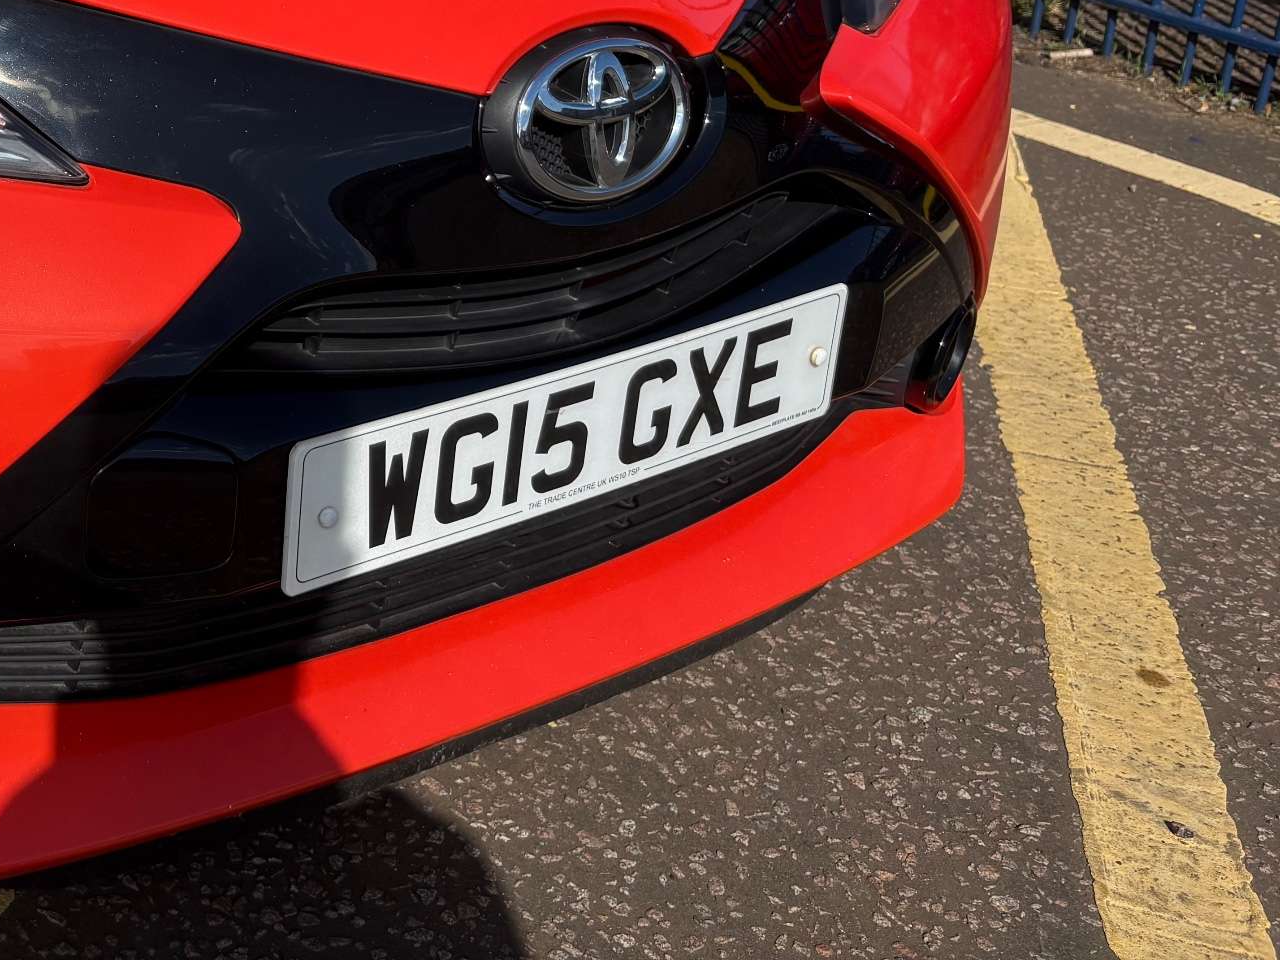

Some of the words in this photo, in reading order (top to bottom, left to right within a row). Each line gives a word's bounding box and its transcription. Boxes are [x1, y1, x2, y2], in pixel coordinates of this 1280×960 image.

[368, 382, 595, 548] WG15
[618, 318, 793, 465] GXE
[528, 499, 541, 511] THE
[544, 491, 567, 506] TRADE
[568, 481, 596, 497] CENTRE
[597, 478, 608, 488] UK
